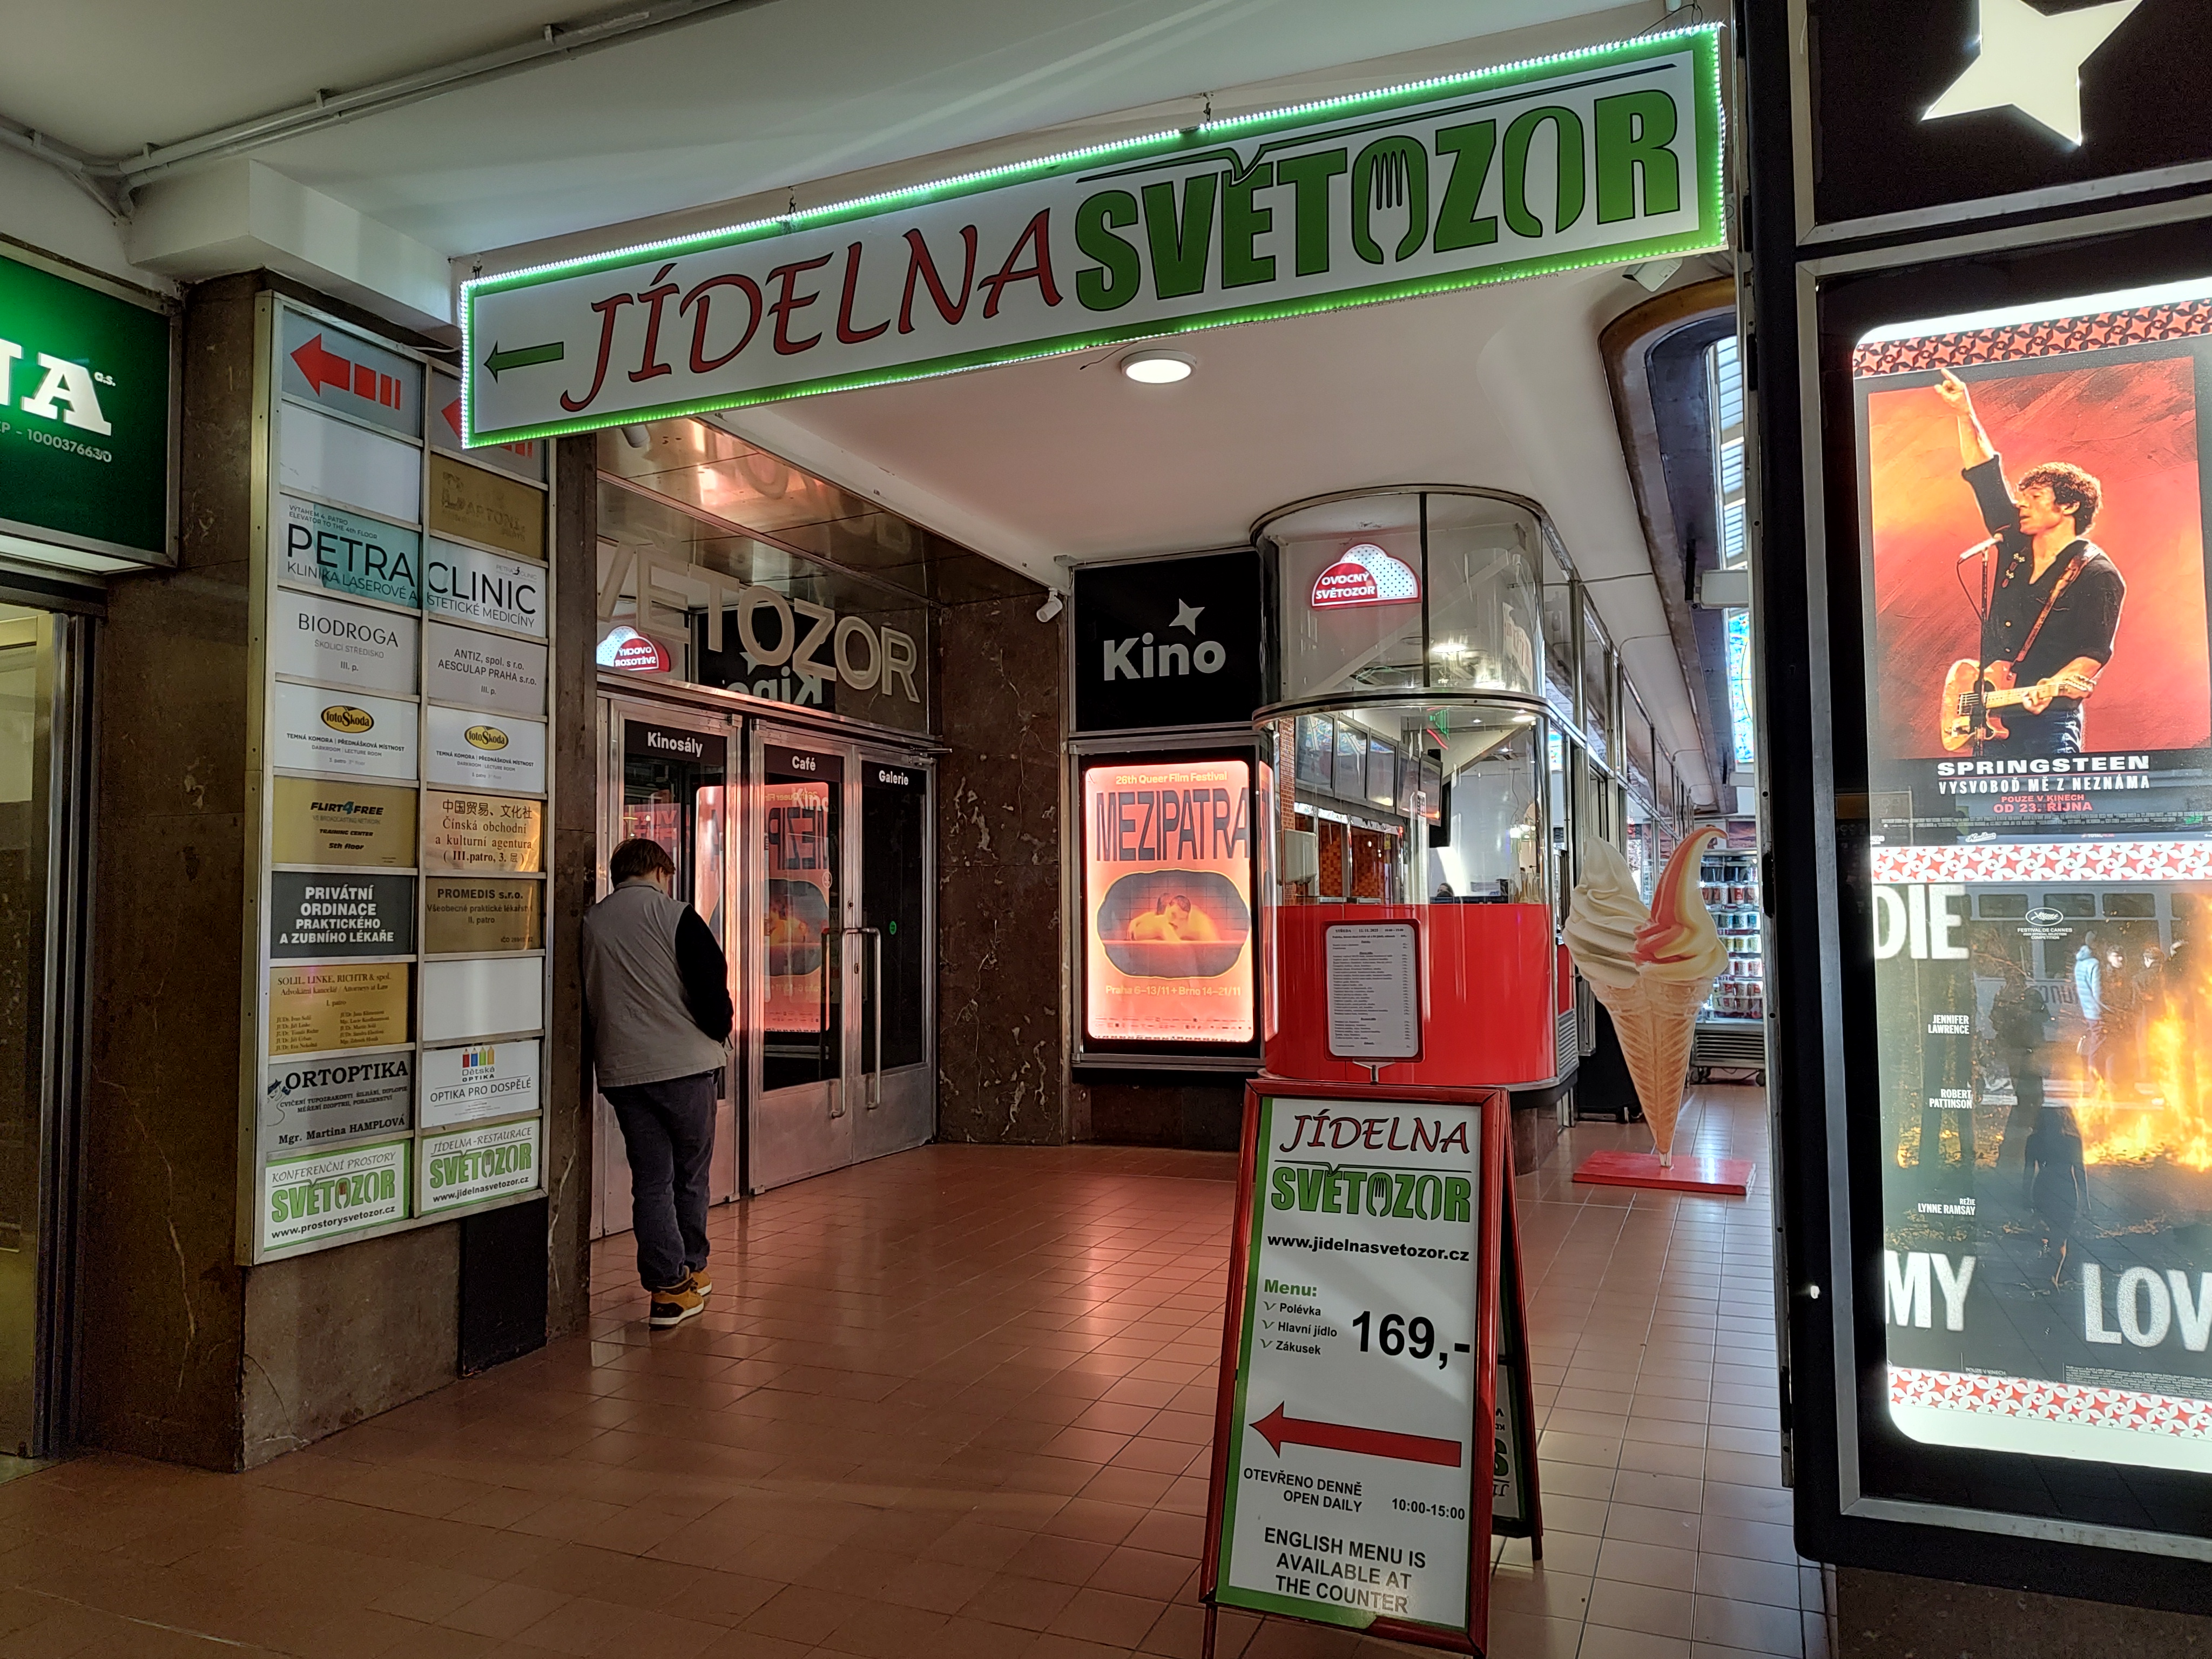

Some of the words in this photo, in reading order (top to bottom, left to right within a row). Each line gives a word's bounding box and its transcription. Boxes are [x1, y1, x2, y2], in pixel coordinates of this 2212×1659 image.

[560, 207, 1064, 413] JÍDELNA
[1075, 89, 1681, 312] SVĚTOZOR
[27, 428, 112, 462] 1000376630
[289, 512, 321, 524] ELEVATOR
[333, 523, 345, 531] THE
[358, 529, 377, 539] FLOOR
[288, 523, 415, 587] PETRA
[428, 562, 536, 615] CLINIC
[1321, 571, 1370, 585] OVOCNÝ
[288, 561, 340, 584] KLINIKA
[342, 574, 407, 599] LASEROVÉ
[483, 607, 535, 628] MEDICÍNY
[1316, 585, 1375, 599] SVĚTOZOR
[298, 613, 399, 648] BIODROGA
[454, 648, 483, 664] ANTIZ,
[485, 655, 504, 669] spol.
[1103, 632, 1226, 681] Kino
[437, 659, 486, 676] AESCULAP
[489, 667, 517, 683] PRAHA
[520, 675, 537, 686] s.r.o.
[338, 739, 377, 748] PŘEDNÁŠKOVÁ
[379, 743, 404, 752] MÍSTNOST
[648, 731, 703, 757] Kinosály
[478, 756, 511, 764] PŘEDNÁŠKOVÁ
[792, 756, 816, 771] Café
[1937, 755, 2149, 776] SPRINGSTEEN
[879, 770, 909, 786] Galerie
[1116, 774, 1137, 785] 26th
[1139, 774, 1168, 784] Queer
[1169, 773, 1189, 783] Film
[1190, 771, 1228, 782] Festival
[1938, 777, 2020, 795] VYSVOBOĎ
[2028, 777, 2049, 792] MĚ
[2056, 778, 2065, 791] Z
[2072, 773, 2150, 791] NEZNÁMA
[311, 801, 383, 815] FLIRT4FREE
[1993, 804, 2017, 813] OD
[2019, 803, 2041, 813] 23.
[2047, 801, 2093, 812] ŘÍJNA
[2046, 794, 2085, 802] KINECH
[443, 815, 477, 831] Čínská
[483, 821, 527, 834] obchodní
[1096, 786, 1250, 862] MEZIPATRA
[435, 836, 441, 845] a
[447, 834, 487, 846] kulturní
[492, 839, 532, 851] agentura
[305, 884, 374, 900] PRIVÁTNÍ
[437, 888, 496, 899] PROMEDIS
[300, 903, 377, 916] ORDINACE
[470, 905, 502, 913] praktické
[296, 917, 381, 930] PRAKTICKÉHO
[476, 916, 495, 925] patro
[1873, 883, 1970, 961] DIE
[279, 933, 288, 944] A
[291, 931, 347, 945] ZUBNÍHO
[349, 930, 394, 943] LÉKAŘE
[1105, 985, 1133, 995] Praha
[1178, 986, 1201, 995] Brno
[1928, 1024, 1970, 1034] LAWRENCE
[1932, 1014, 1969, 1024] JENNIFER
[285, 1060, 408, 1090] ORTOPTIKA
[462, 1066, 495, 1076] Dětská
[462, 1074, 495, 1082] OPTIKA
[430, 1089, 466, 1102] OPTIKA
[468, 1085, 488, 1097] PRO
[491, 1077, 531, 1093] DOSPĚLÉ
[1940, 1088, 1972, 1099] ROBERT
[1929, 1098, 1973, 1109] PATTINSON
[279, 1134, 302, 1144] Mgr.
[306, 1127, 346, 1140] Martina
[349, 1114, 405, 1133] HAMPLOVÁ
[1280, 1109, 1470, 1155] JÍDELNA
[272, 1160, 344, 1183] KONFERENČNÍ
[347, 1151, 396, 1169] PROSTORY
[429, 1142, 531, 1189] SVĚTOZOR
[271, 1169, 395, 1223] SVĚTOZOR
[433, 1176, 529, 1203] www.jidelnasvetozor.cz
[1271, 1161, 1472, 1223] SVĚTOZOR
[1918, 1203, 1943, 1214] LYNNE
[1943, 1204, 1976, 1216] RAMSAY
[1959, 1197, 1976, 1205] REŽIE
[272, 1205, 395, 1239] www.prostorysvetozor.cz
[1267, 1234, 1469, 1262] www.jidelnasvetozor.cz
[1264, 1279, 1317, 1297] Menu:
[1884, 1250, 1977, 1332] MY
[1279, 1302, 1321, 1317] Polévka
[1278, 1321, 1311, 1335] Hlavní
[1313, 1325, 1338, 1338] jídlo
[1276, 1340, 1321, 1355] Zákusek
[1352, 1310, 1471, 1371] 169,-
[1244, 1467, 1314, 1490] OTEVŘENO
[1317, 1478, 1363, 1496] DENNĚ
[1283, 1489, 1319, 1506] OPEN
[1323, 1495, 1363, 1513] DAILY
[1391, 1498, 1466, 1520] 10:00-15:00
[1265, 1527, 1343, 1555] ENGLISH
[1349, 1541, 1402, 1564] MENU
[1409, 1550, 1426, 1568] IS
[1276, 1553, 1381, 1586] AVAILABLE
[1386, 1571, 1412, 1590] AT
[1276, 1575, 1310, 1596] THE
[1316, 1582, 1408, 1614] COUNTER
